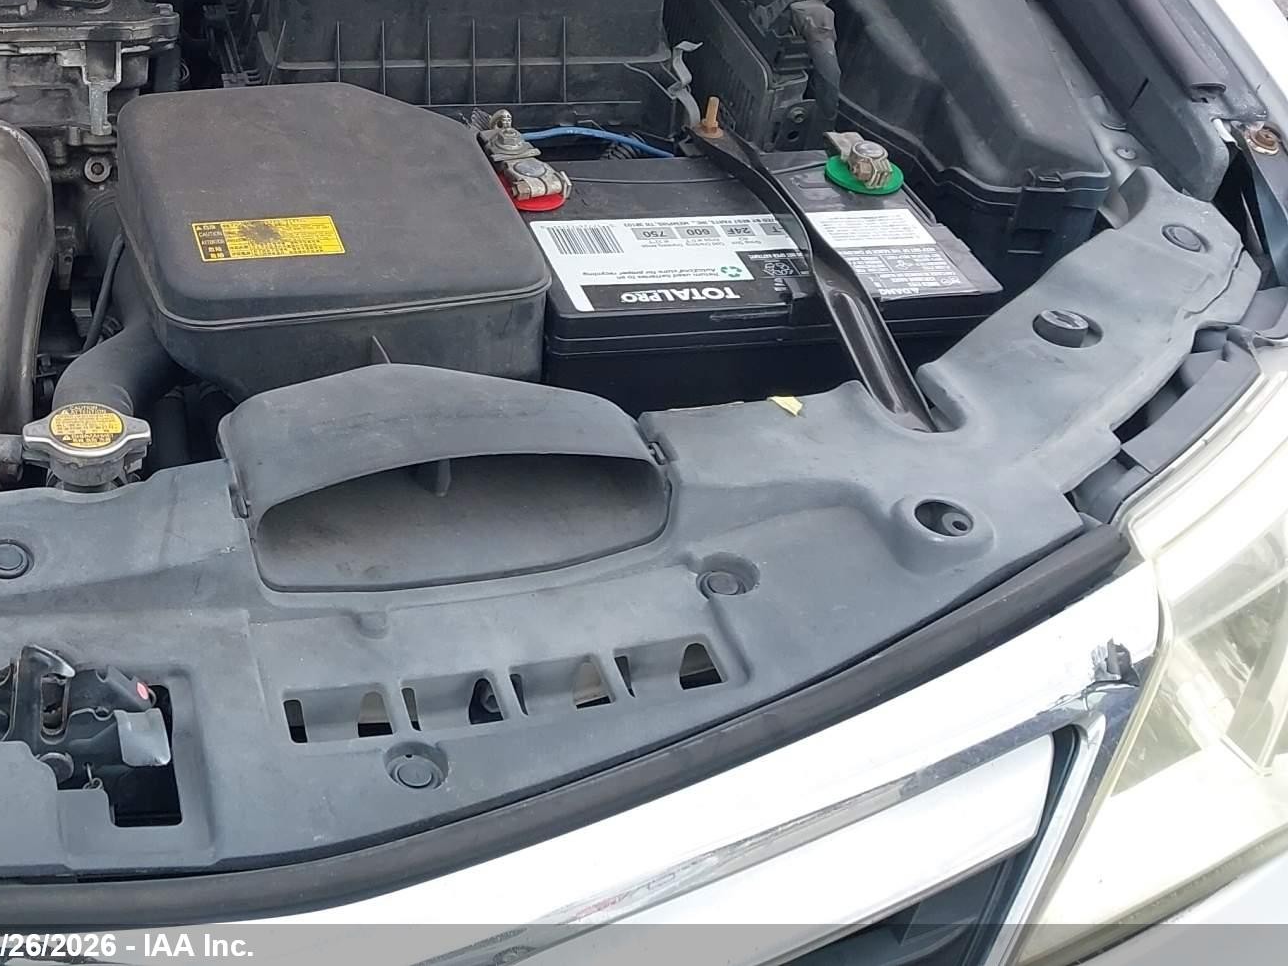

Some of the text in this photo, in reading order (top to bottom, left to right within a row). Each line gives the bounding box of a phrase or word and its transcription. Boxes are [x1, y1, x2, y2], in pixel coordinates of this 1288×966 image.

[642, 230, 667, 238] 750
[686, 228, 711, 236] 600
[726, 227, 751, 235] 24F
[621, 286, 741, 304] TOTALPRO
